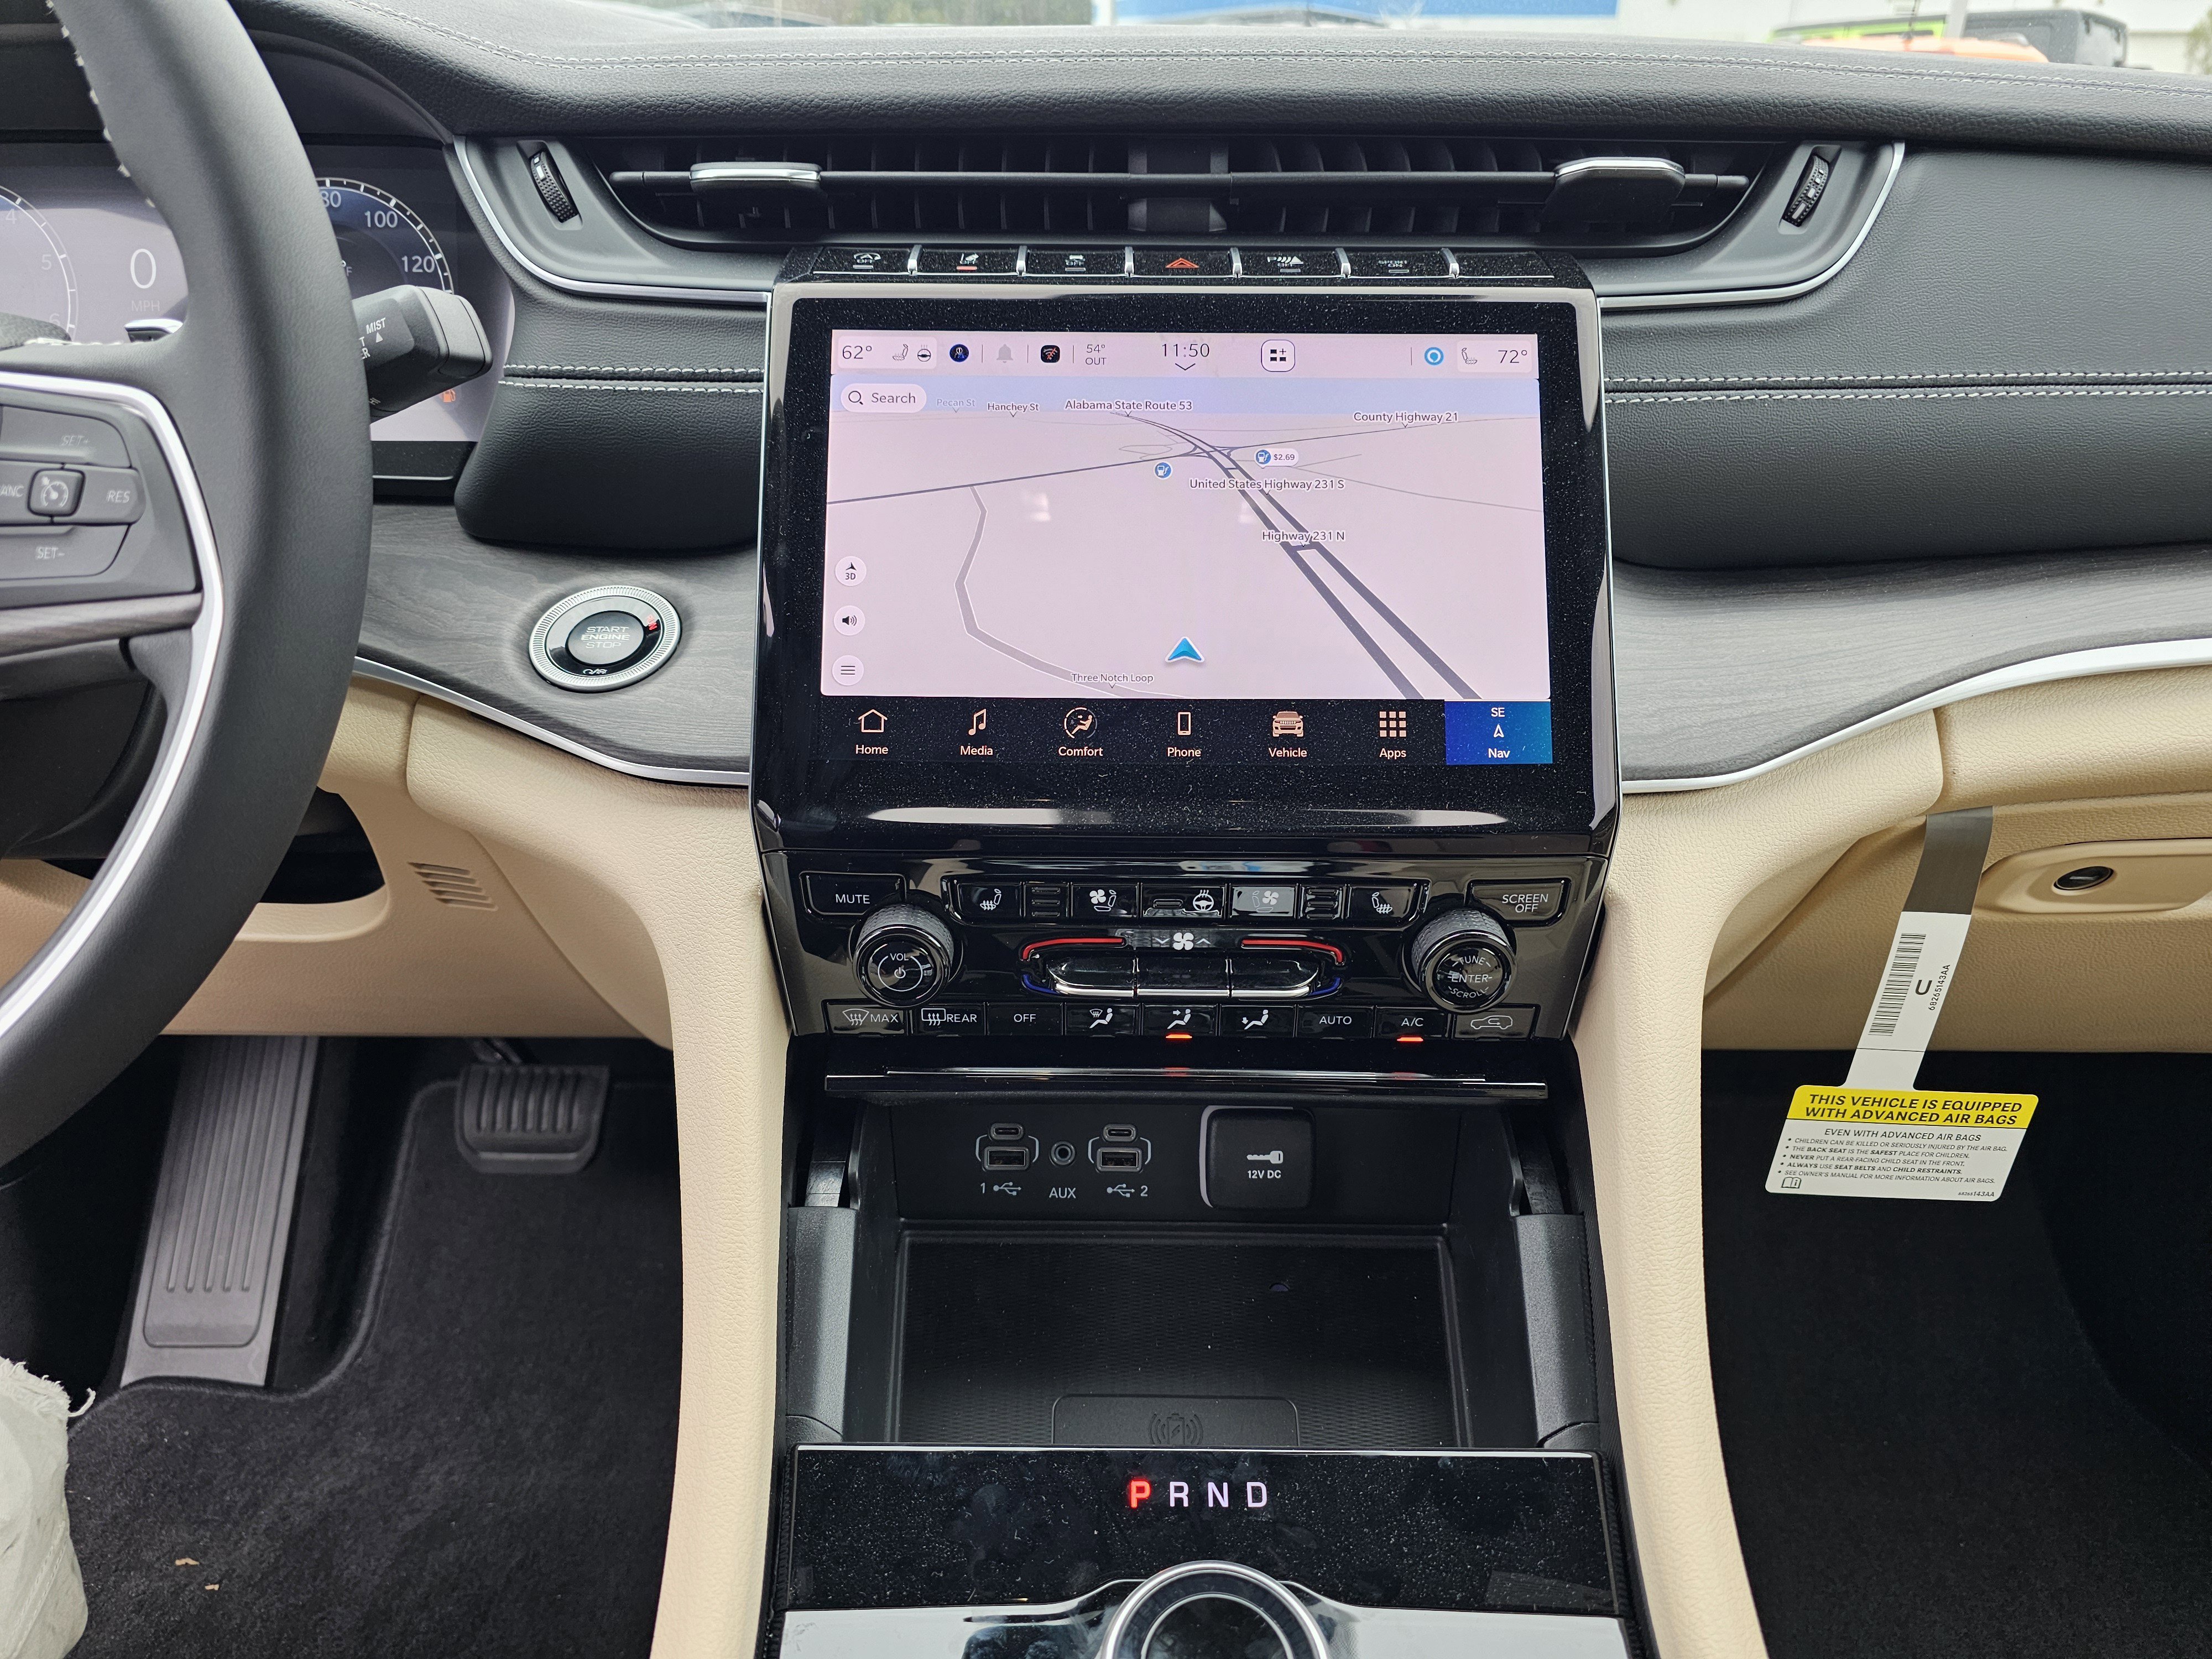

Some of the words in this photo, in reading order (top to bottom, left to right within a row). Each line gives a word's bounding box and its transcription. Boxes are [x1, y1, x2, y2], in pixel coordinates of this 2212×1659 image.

[6, 208, 17, 224] 4
[364, 211, 398, 228] 100
[41, 254, 52, 270] 5
[401, 255, 435, 273] 120
[130, 248, 156, 289] 0
[132, 300, 160, 312] MPH
[366, 317, 386, 334] MIST
[1161, 343, 1210, 358] 11:50
[1085, 357, 1106, 366] OUT
[871, 392, 916, 404] Search
[937, 399, 963, 407] Pecan
[966, 399, 975, 407] St
[988, 403, 1027, 412] Hanchey
[1029, 403, 1039, 411] St
[1065, 400, 1112, 410] Alabama
[1115, 400, 1142, 410] State
[1145, 401, 1176, 410] Route
[1179, 401, 1192, 410] 53
[1353, 412, 1393, 424] County
[1395, 412, 1442, 424] Highway
[1445, 412, 1458, 421] 21
[1273, 453, 1295, 461] $2.69
[1190, 479, 1225, 489] United
[1229, 479, 1262, 489] States
[1265, 479, 1312, 492] Highway
[1314, 479, 1334, 489] 231
[1337, 479, 1345, 489] S
[106, 491, 131, 503] RES
[1262, 531, 1311, 542] Highway
[1312, 531, 1333, 541] 231
[1336, 531, 1345, 541] N
[845, 572, 856, 581] 3D
[1072, 672, 1098, 682] Three
[1100, 673, 1128, 683] Notch
[1130, 673, 1154, 685] Loop
[1491, 707, 1505, 718] SE
[855, 744, 889, 755] Home
[960, 745, 993, 756] Media
[1058, 745, 1103, 757] Comfort
[1167, 747, 1201, 758] Phone
[1269, 747, 1307, 758] Vehicle
[1379, 748, 1407, 760] Apps
[1488, 748, 1510, 759] Nav
[835, 893, 870, 905] MUTE
[1501, 893, 1548, 904] SCREEN
[1515, 904, 1538, 913] OFF
[890, 952, 909, 961] VOL
[1458, 955, 1486, 966] TUNE
[1451, 973, 1489, 983] ENTER
[1928, 964, 1950, 1011] 68265143AA
[1450, 988, 1487, 999] SCROLL
[870, 1014, 899, 1023] MAX
[947, 1014, 978, 1022] REAR
[1014, 1014, 1036, 1022] OFF
[1319, 1016, 1352, 1025] AUTO
[1401, 1017, 1424, 1027] A/C
[1809, 1094, 1846, 1105] THIS
[1851, 1095, 1919, 1109] VEHICLE
[1922, 1099, 1938, 1109] IS
[1942, 1100, 2022, 1113] EQUIPPED
[1806, 1107, 1847, 1118] WITH
[1850, 1109, 1940, 1122] ADVANCED
[1943, 1113, 1971, 1124] AIR
[1974, 1114, 2018, 1125] BAGS
[1880, 1131, 1934, 1140] ADVANCED
[1247, 1170, 1265, 1179] 12V
[1267, 1170, 1281, 1179] DC
[980, 1183, 986, 1194] 1
[1048, 1187, 1077, 1199] AUX
[1140, 1185, 1148, 1197] 2
[1130, 1480, 1151, 1509] P
[1169, 1481, 1189, 1507] R
[1208, 1481, 1229, 1508] N
[1246, 1481, 1268, 1508] D
